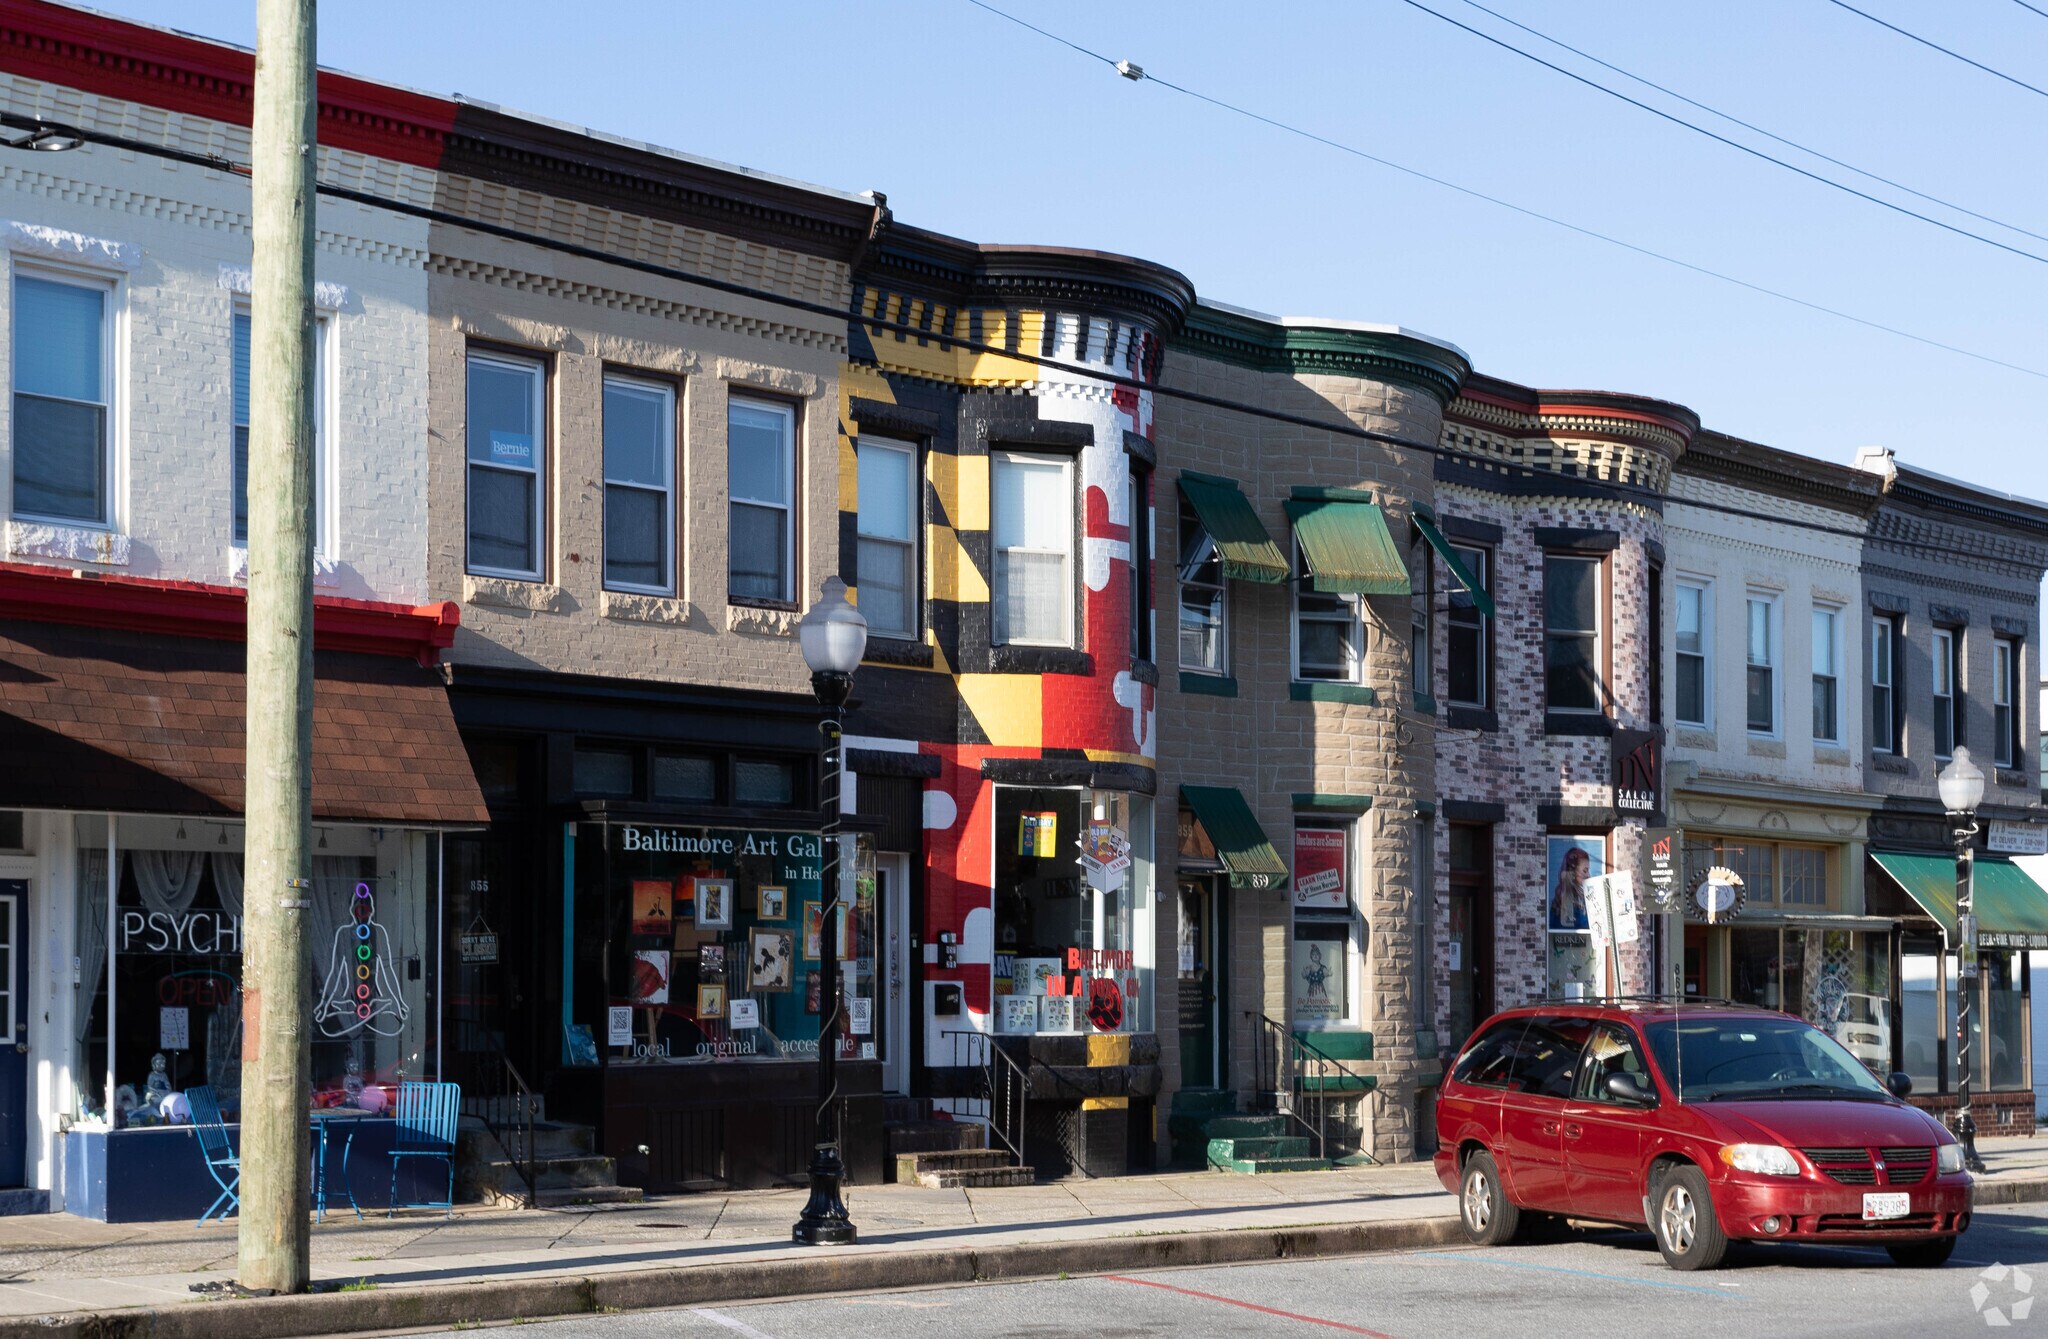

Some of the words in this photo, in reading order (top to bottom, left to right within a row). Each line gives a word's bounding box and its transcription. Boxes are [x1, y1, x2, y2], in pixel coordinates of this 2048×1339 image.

[493, 440, 530, 457] Bernie
[1618, 788, 1655, 801] SALON
[1618, 798, 1655, 811] COLLECTIVE
[623, 828, 734, 856] Baltimore
[742, 833, 778, 857] Art
[786, 835, 858, 864] Galry
[1652, 836, 1671, 855] IN
[785, 866, 797, 880] in
[801, 867, 861, 881] Haden
[1252, 874, 1269, 889] 859
[470, 880, 489, 892] 855
[124, 912, 244, 953] PSYCHI
[1555, 935, 1585, 944] REDKEN
[2008, 933, 2026, 947] WINES
[1067, 947, 1134, 971] BALTIMOR
[159, 974, 231, 1006] OPEN
[1046, 975, 1066, 998] IN
[1072, 976, 1084, 998] A
[633, 1037, 671, 1057] local
[696, 1034, 757, 1059] original
[782, 1034, 854, 1053] accesle
